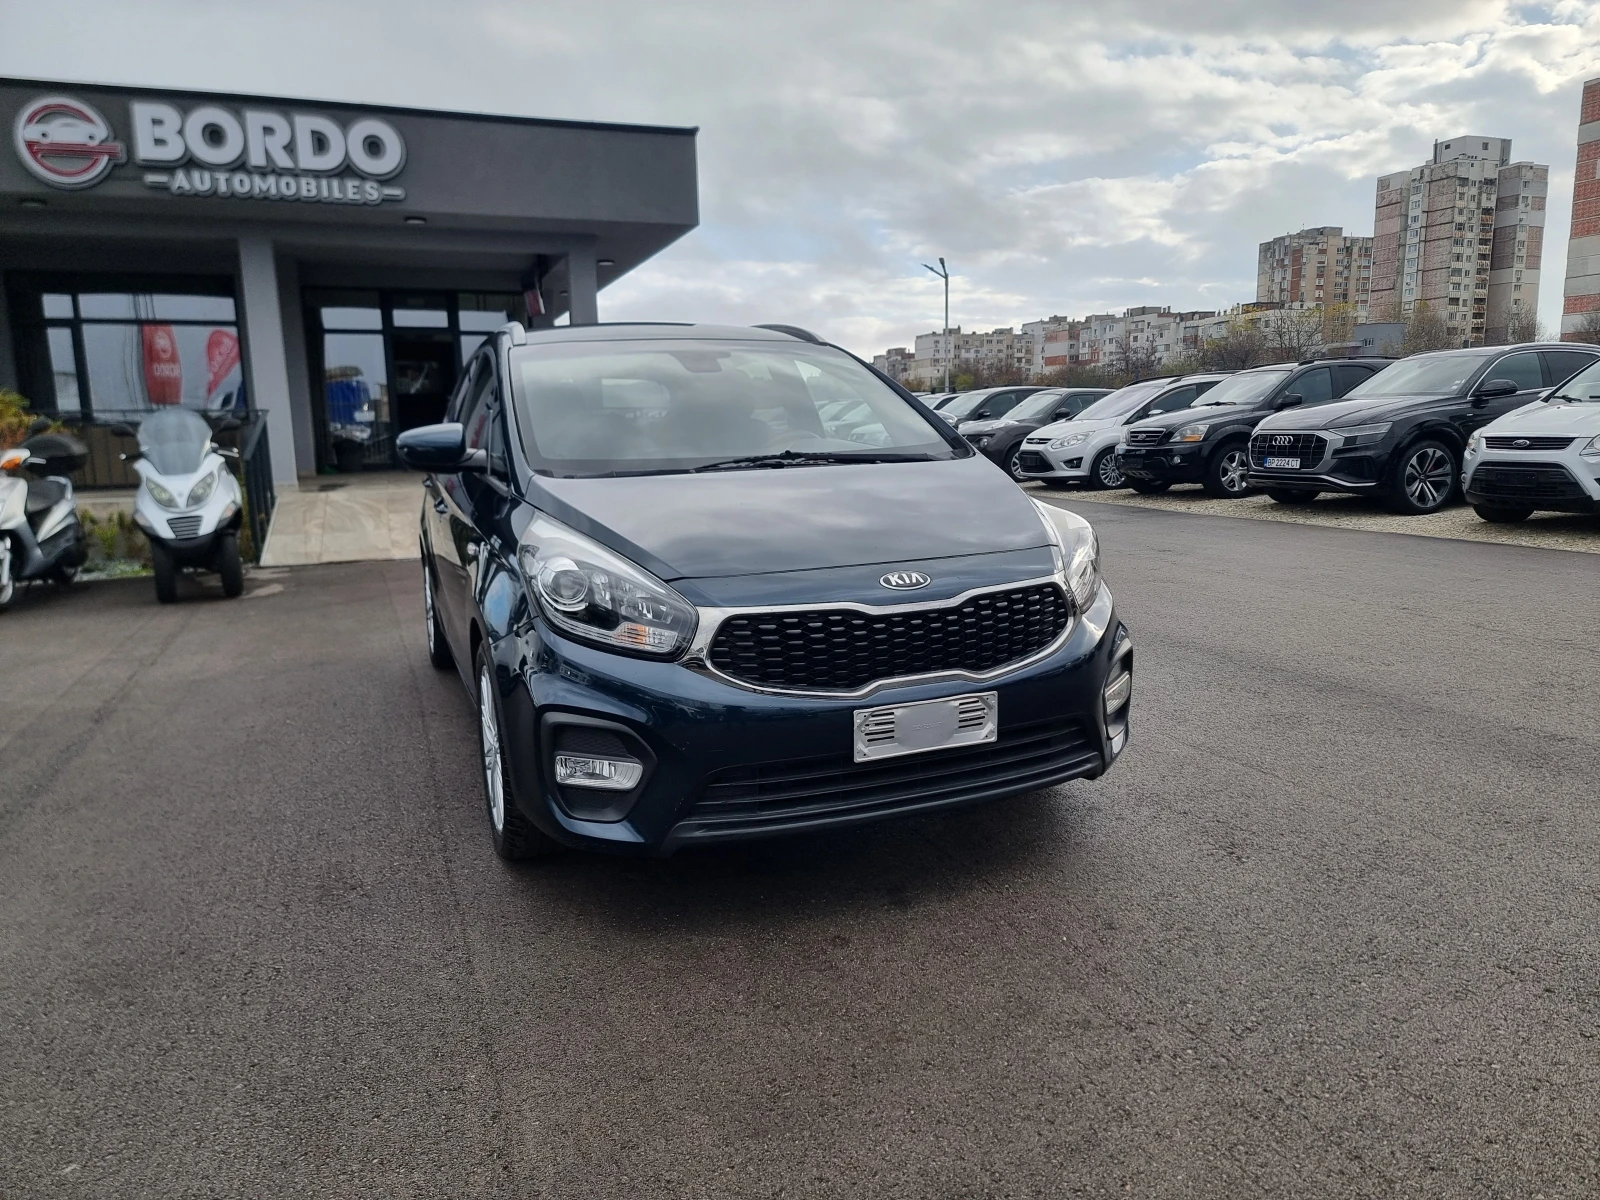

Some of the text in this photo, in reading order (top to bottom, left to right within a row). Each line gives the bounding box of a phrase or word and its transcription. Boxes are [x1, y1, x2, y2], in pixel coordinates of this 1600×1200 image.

[131, 101, 403, 175] BORDO
[171, 168, 381, 201] AUTOMOBILES
[887, 572, 925, 586] KIA
